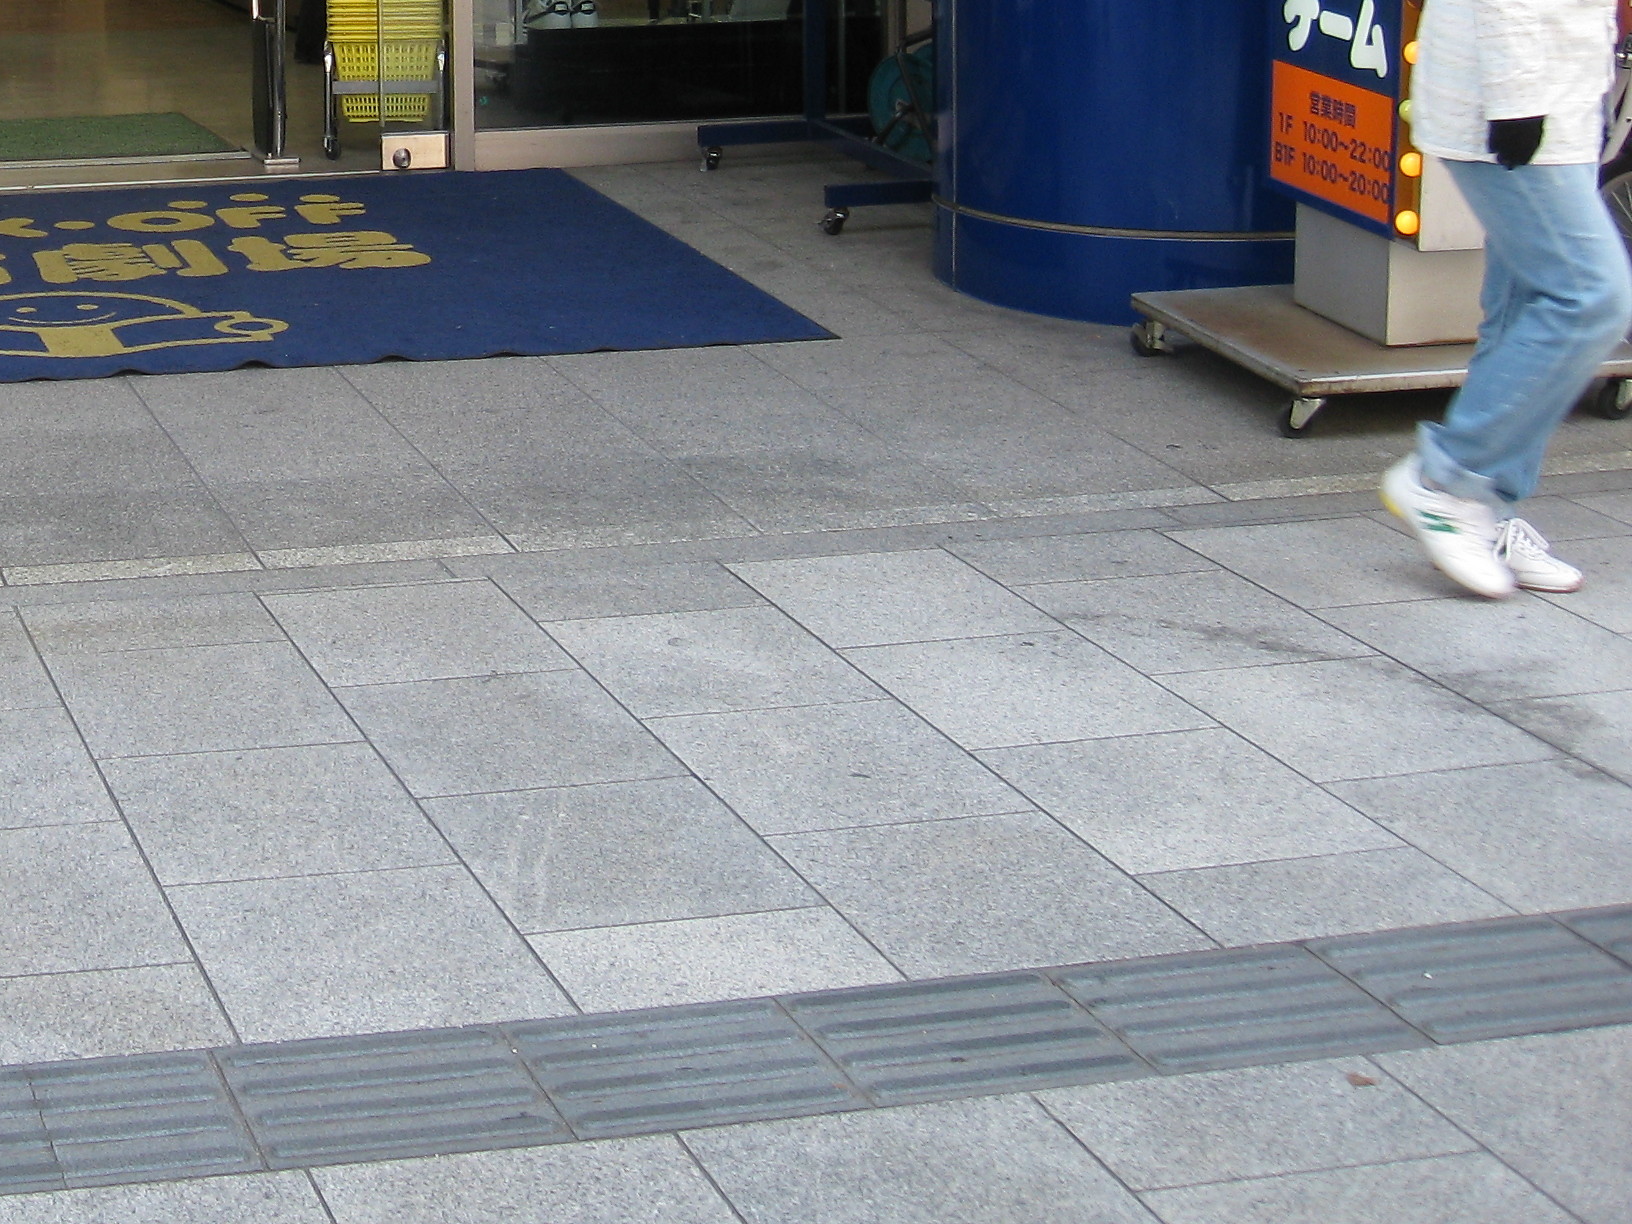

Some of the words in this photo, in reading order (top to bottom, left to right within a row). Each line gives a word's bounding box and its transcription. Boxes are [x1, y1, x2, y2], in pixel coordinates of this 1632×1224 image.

[1310, 90, 1357, 129] 営業時間
[1278, 111, 1294, 135] 1F
[1274, 141, 1296, 167] B1F
